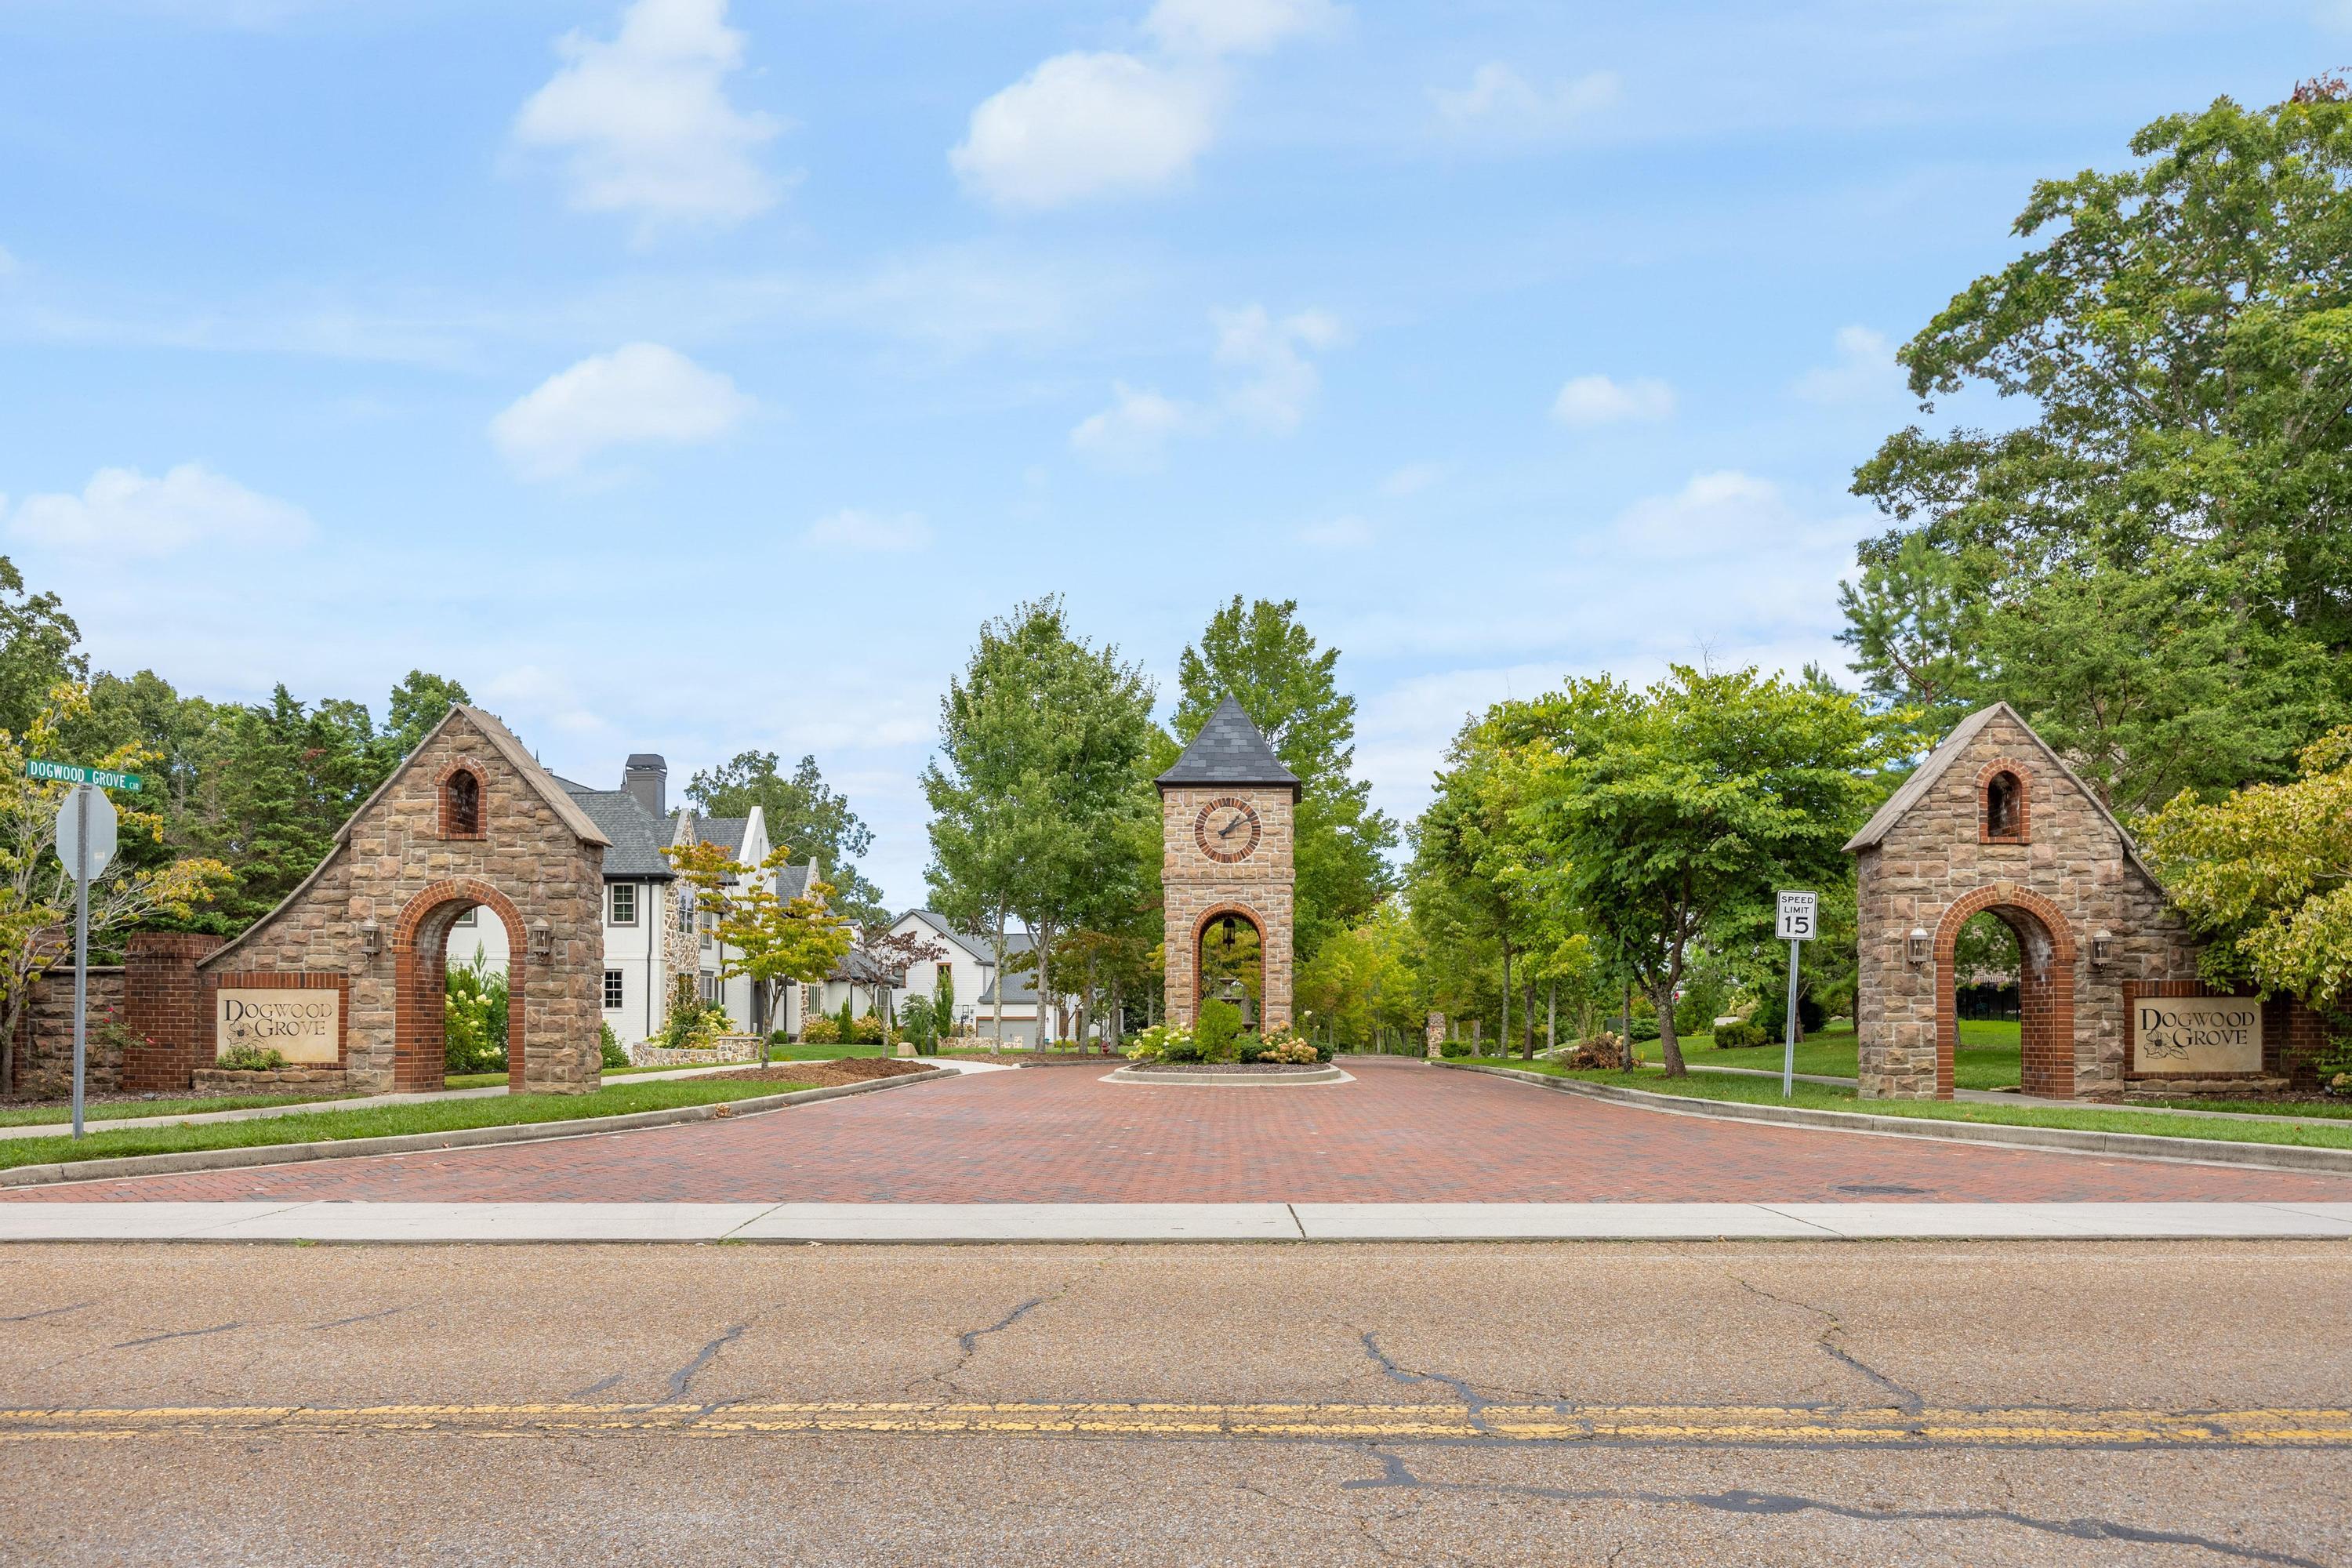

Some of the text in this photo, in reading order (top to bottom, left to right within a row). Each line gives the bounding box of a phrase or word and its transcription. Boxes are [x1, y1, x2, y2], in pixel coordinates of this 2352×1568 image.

[31, 761, 140, 791] DOGWOOD GROVE CIR
[1781, 895, 1813, 904] SPEED
[1785, 916, 1809, 934] 15
[223, 1000, 332, 1021] DOGWOOD
[2140, 1008, 2255, 1030] DOGWOOD
[255, 1018, 325, 1037] GROVE
[2172, 1028, 2247, 1047] GROVE
